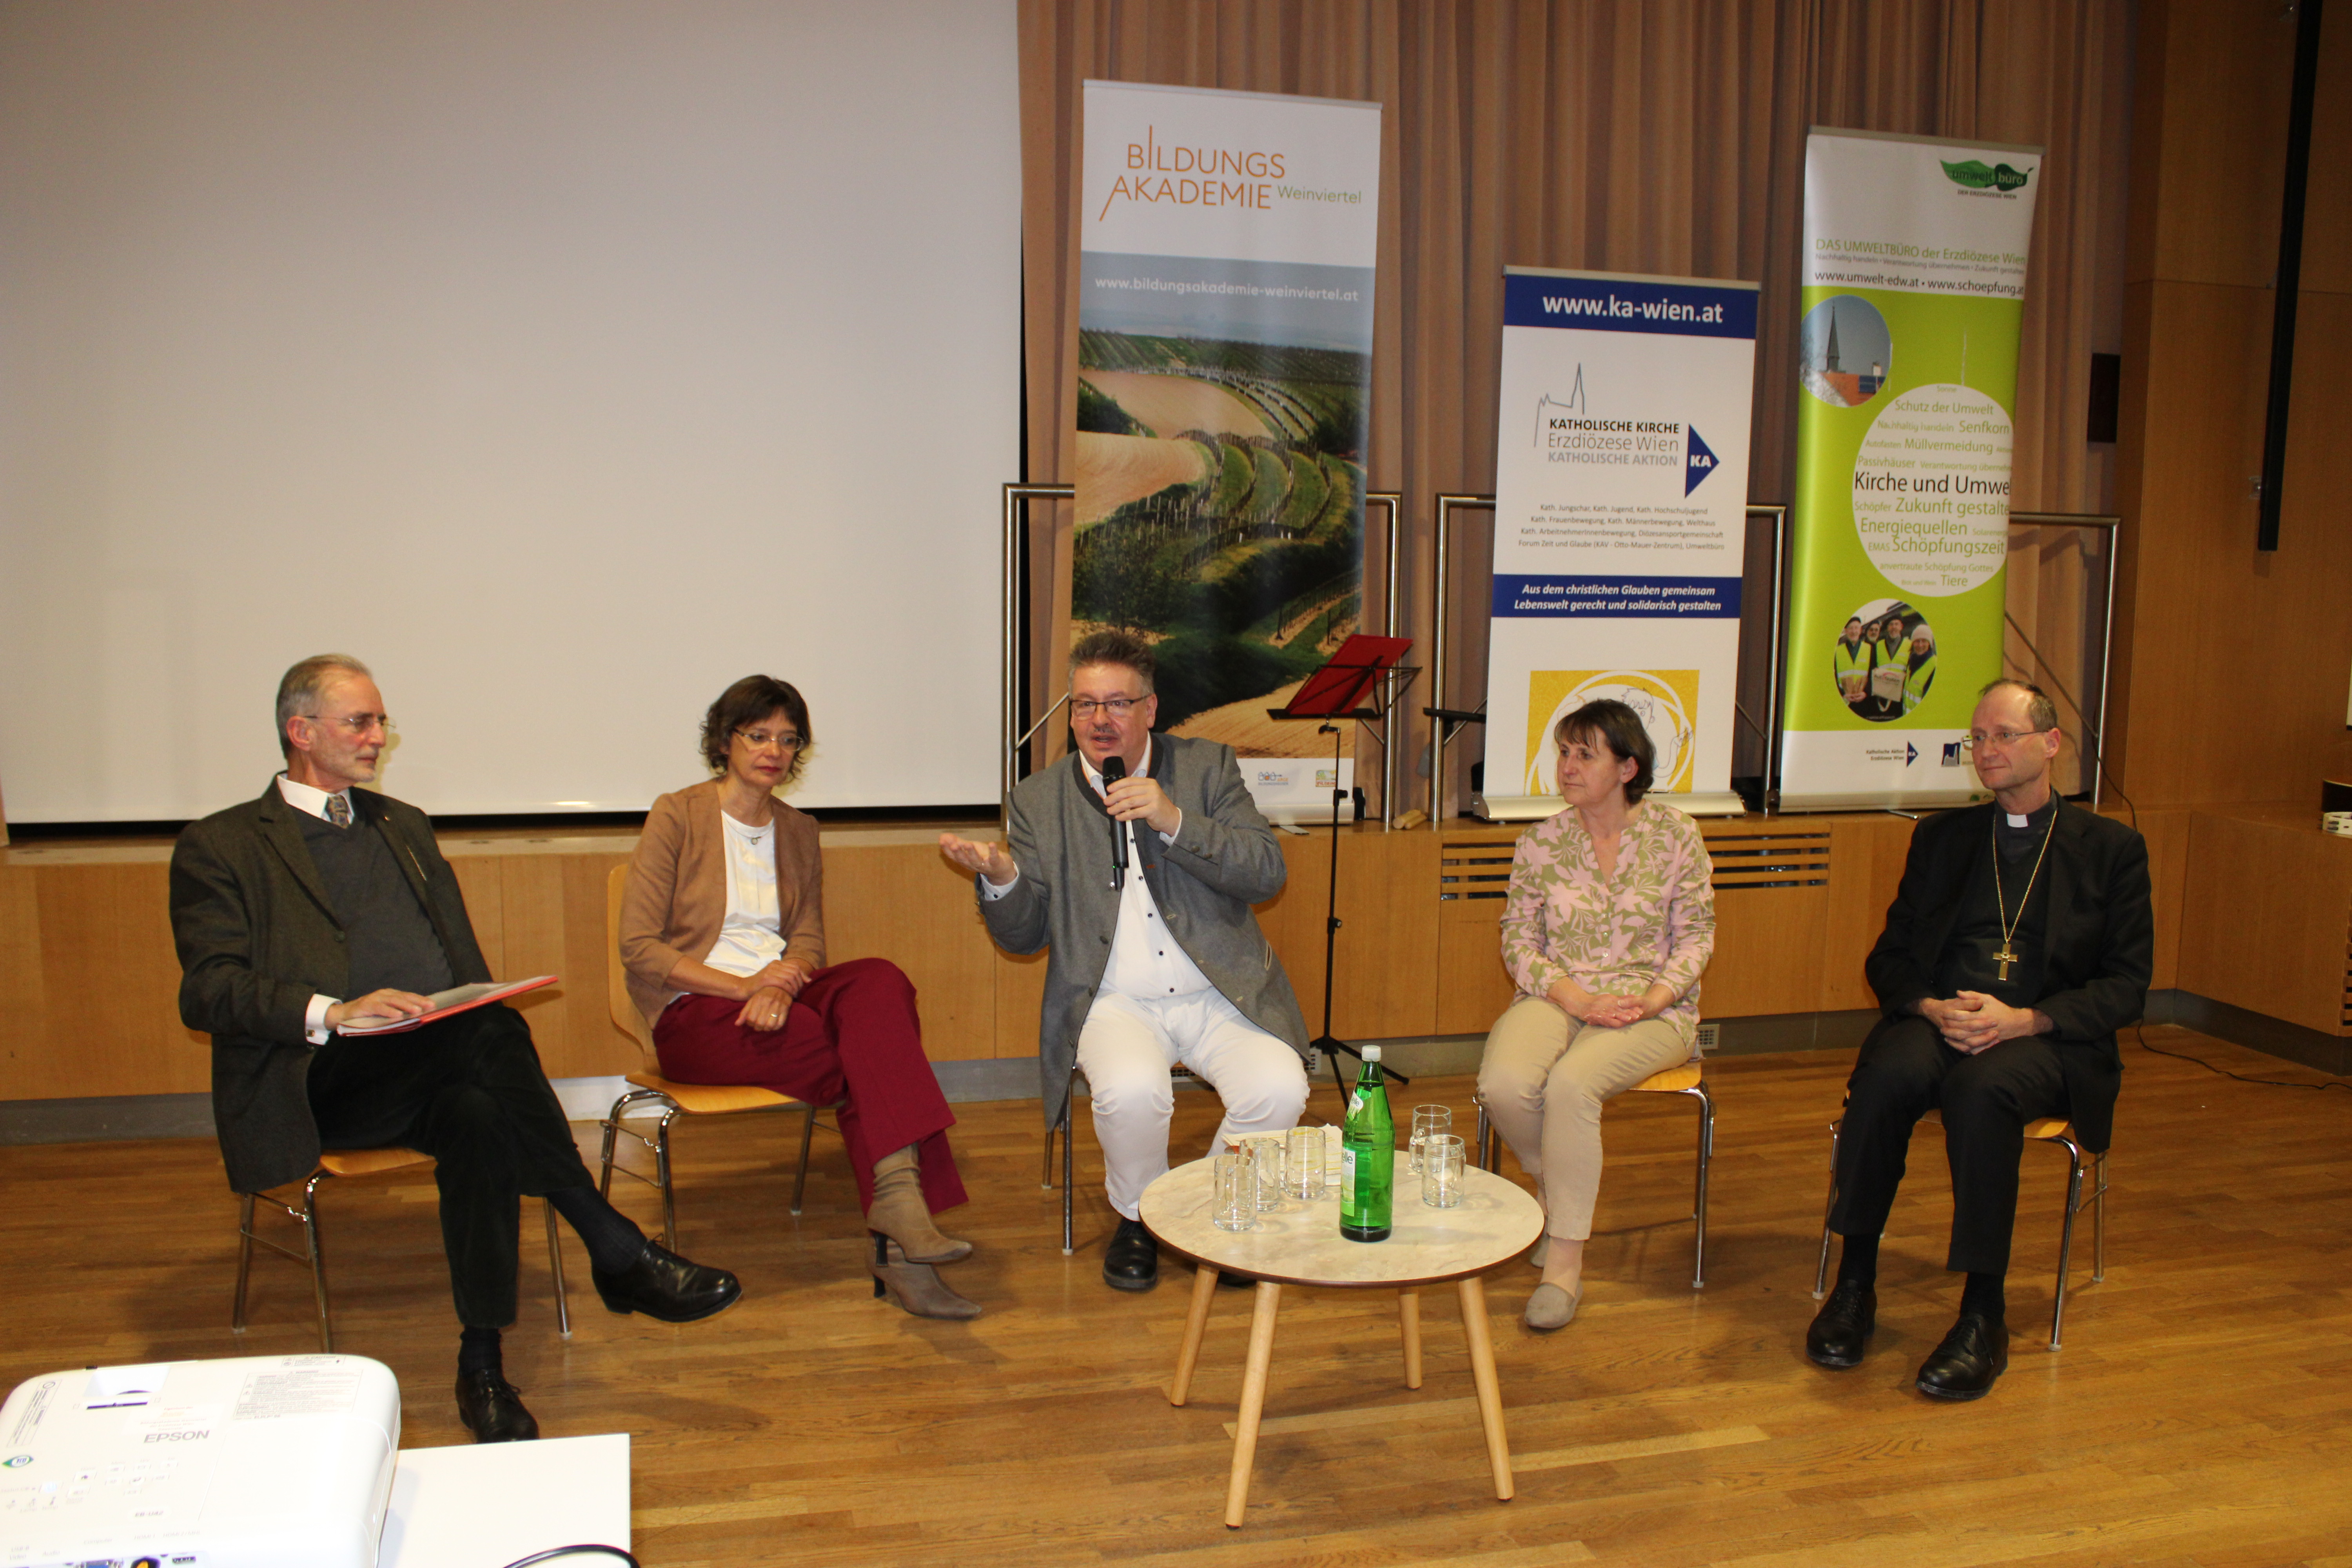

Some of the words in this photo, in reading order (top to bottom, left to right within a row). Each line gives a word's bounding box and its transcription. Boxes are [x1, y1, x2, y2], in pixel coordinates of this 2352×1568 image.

[1127, 125, 1285, 178] BILDUNGS
[1998, 172, 2023, 184] büro
[1099, 175, 1272, 221] AKADEMIE
[1278, 185, 1362, 204] Weinviertel
[1816, 239, 1841, 250] DAS
[1844, 240, 1919, 257] UMWELTBÜRO
[1922, 247, 1940, 259] der
[1944, 248, 2000, 263] Erzdiözese
[2002, 253, 2025, 264] Wien
[1095, 276, 1358, 302] www.bildungsakademie-weinviertel.at
[1815, 272, 1918, 287] www.umwelt-edw.at
[1928, 279, 2024, 296] www.schoepfung.at
[1543, 294, 1723, 324] www.ka-wien.at
[1895, 399, 1929, 412] Schutz
[1932, 401, 1949, 413] der
[1952, 403, 1994, 415] Umwelt
[1550, 419, 1632, 432] KATHOLISCHE
[1636, 422, 1679, 434] KIRCHE
[1878, 420, 1918, 432] Nachhaltig
[1959, 420, 2010, 434] Senfkorn
[1549, 432, 1632, 450] Erzdiözese
[1636, 436, 1679, 452] Wien
[1866, 440, 1901, 449] Autofasten
[1905, 438, 1993, 455] Müllvermeidung
[1548, 453, 1629, 465] KATHOLISCHE
[1633, 454, 1678, 466] AKTION
[1690, 454, 1711, 467] KA
[1858, 456, 1915, 468] Passivhäuser
[1920, 461, 1977, 473] Verantwortung
[1855, 472, 1907, 491] Kirche
[1913, 474, 1949, 493] und
[1956, 475, 2011, 495] Umwel
[1654, 507, 1708, 515] Hochschuljugend
[1855, 502, 1891, 513] Schöpfer
[1895, 497, 1953, 514] Zukunft
[1957, 501, 2009, 518] gestalte
[1550, 516, 1606, 525] Frauenbewegung,
[1626, 518, 1684, 526] Männerbewegung,
[1860, 517, 1967, 537] Energiequellen
[1639, 530, 1723, 538] Diözesansportgemeinschaft
[1868, 542, 1890, 551] EMAS
[1892, 536, 2004, 557] Schöpfungszeit
[1924, 563, 1967, 573] Schöpfung
[1968, 564, 1993, 572] Gottes
[1941, 575, 1968, 586] Tiere
[1522, 584, 1541, 595] Aus
[1543, 584, 1564, 595] dem
[1566, 584, 1619, 595] christlichen
[1621, 585, 1661, 596] Glauben
[1662, 586, 1715, 598] gemeinsam
[1514, 600, 1569, 610] Lebenswelt
[1570, 600, 1606, 612] gerecht
[1608, 601, 1626, 611] und
[1628, 601, 1676, 611] solidarisch
[1678, 601, 1722, 612] gestalten
[144, 1430, 210, 1443] EPSON
